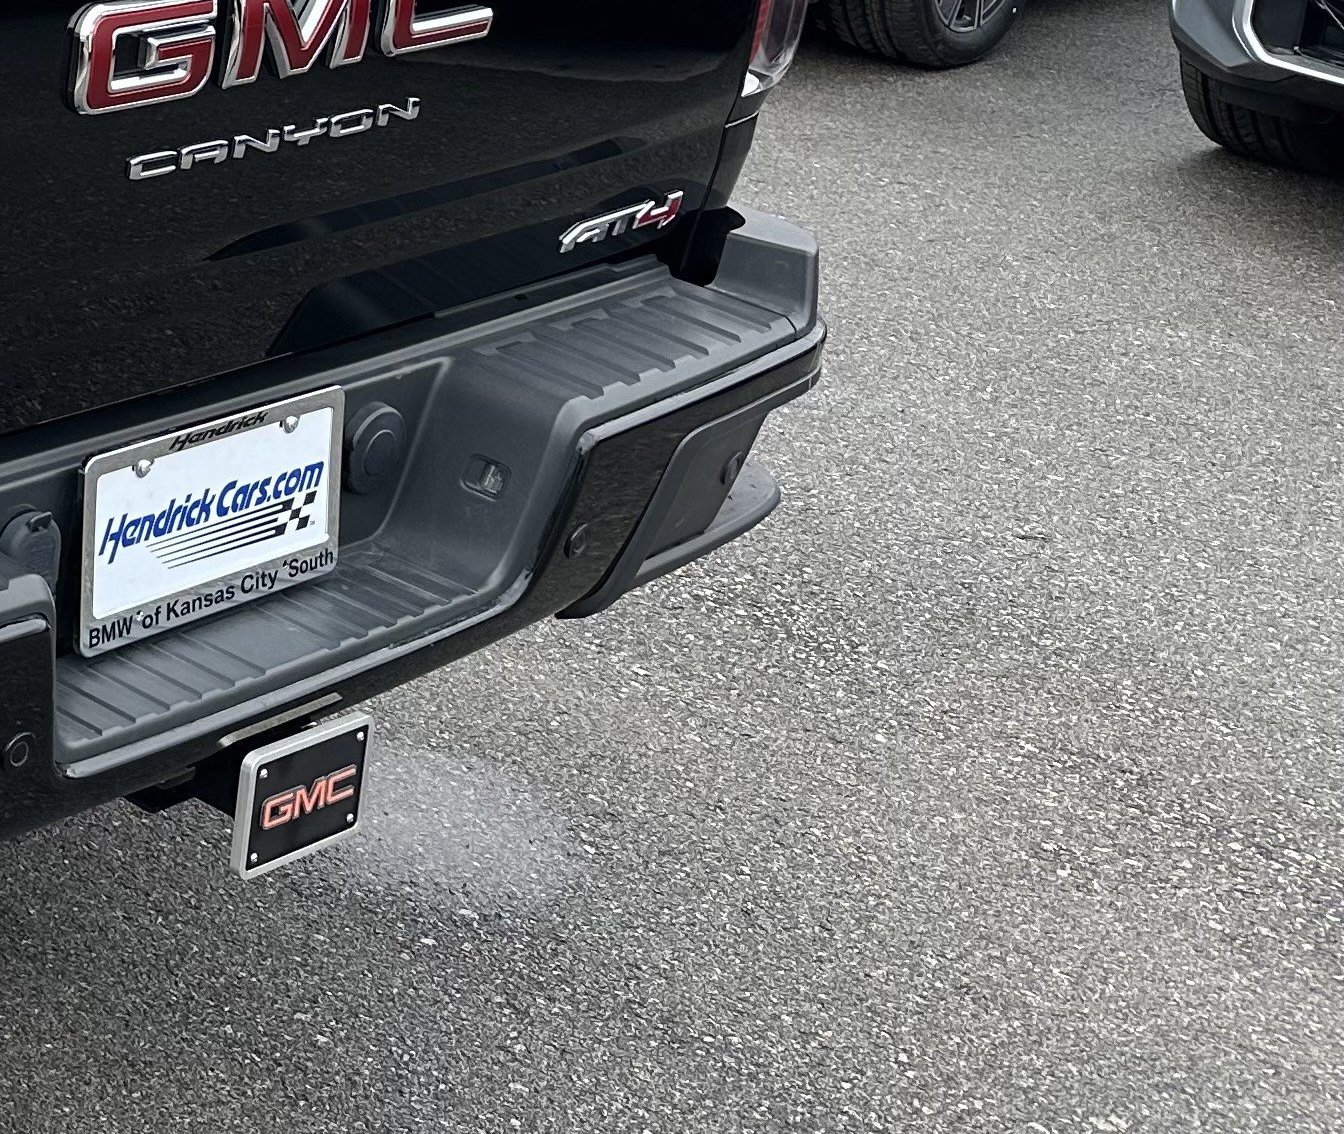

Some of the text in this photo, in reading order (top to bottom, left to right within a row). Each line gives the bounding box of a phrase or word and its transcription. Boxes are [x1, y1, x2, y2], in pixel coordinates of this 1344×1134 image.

[125, 97, 420, 180] CANYON
[559, 190, 684, 253] AT4
[169, 411, 268, 451] Hendrick
[89, 548, 334, 648] BMW of Kansas City South
[260, 764, 357, 830] GMC
